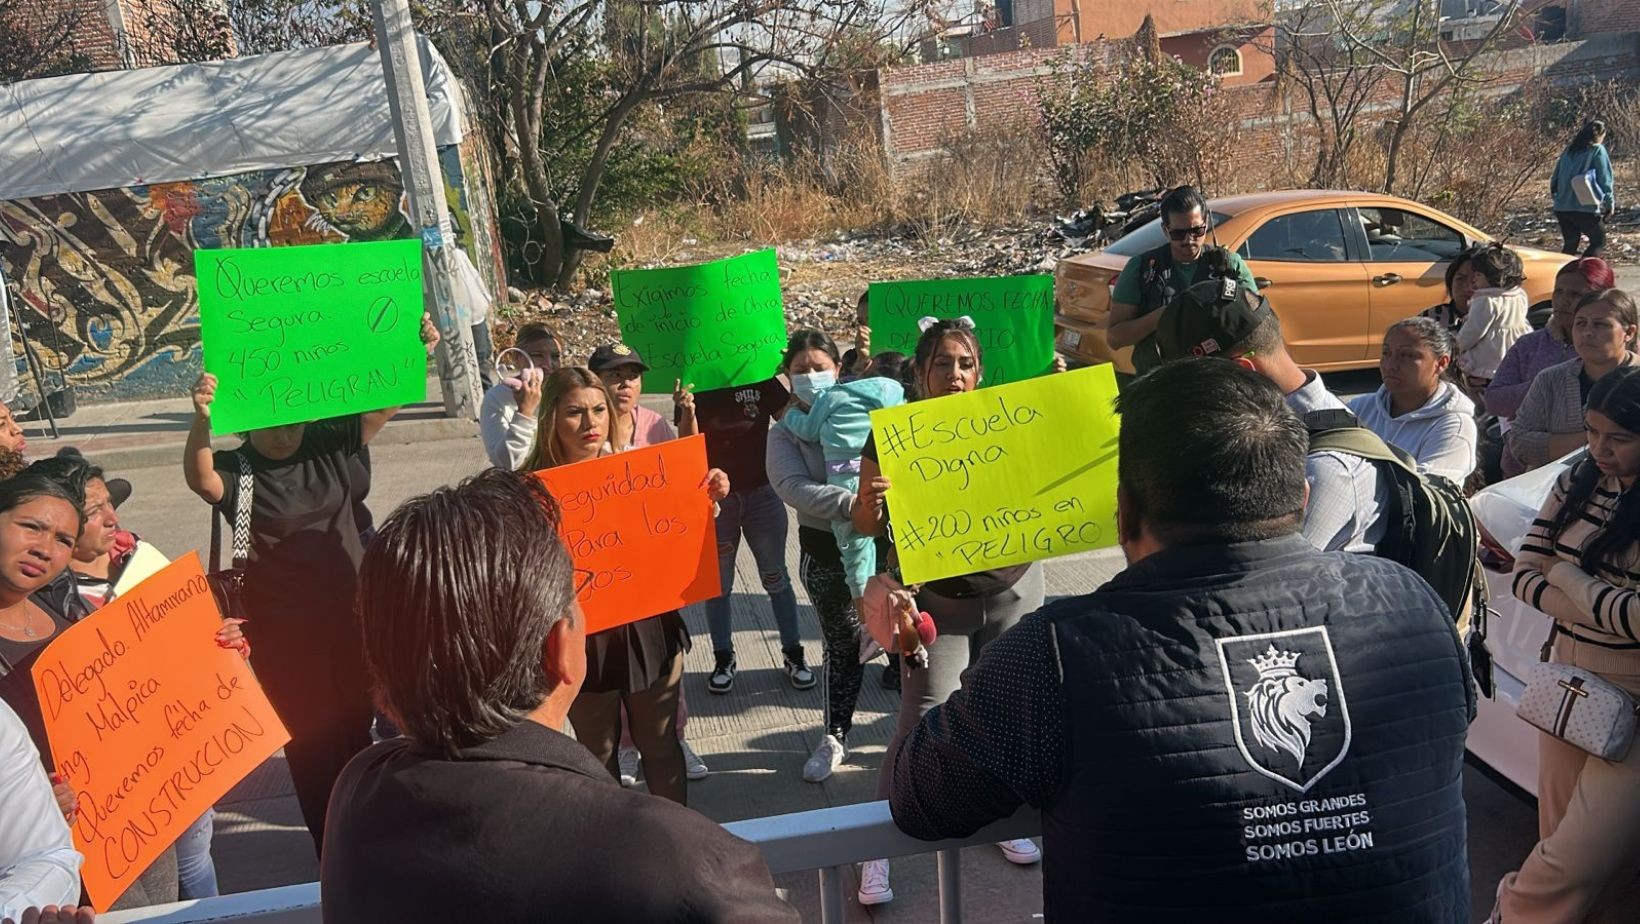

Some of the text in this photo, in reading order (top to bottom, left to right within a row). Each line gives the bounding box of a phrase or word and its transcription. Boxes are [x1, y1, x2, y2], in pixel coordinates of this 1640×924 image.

[215, 256, 345, 301] Queremos
[358, 257, 421, 287] escuela
[617, 262, 772, 317] Exigimos fecha
[884, 284, 1049, 317] QUEREMOS FECHA
[625, 314, 646, 335] de
[652, 312, 701, 334] inicio
[715, 302, 738, 322] de
[228, 340, 350, 380] 450 niños
[646, 330, 782, 369] Escuela Segura
[882, 396, 1044, 458] #Escuela
[560, 453, 668, 524] eguridad
[909, 444, 1009, 490] Digna
[565, 501, 689, 559] Para los
[899, 496, 1084, 551] #200 niños en
[127, 574, 208, 642] Altamirano
[85, 676, 161, 741] Malpica
[74, 745, 166, 844] Queremos
[216, 673, 244, 700] de
[104, 705, 265, 880] CONSTRUCCION
[1243, 793, 1367, 820] SOMOS GRANDES
[1244, 811, 1371, 839] SOMOS FUERTES
[1245, 829, 1374, 862] SOMOS LEÓN
